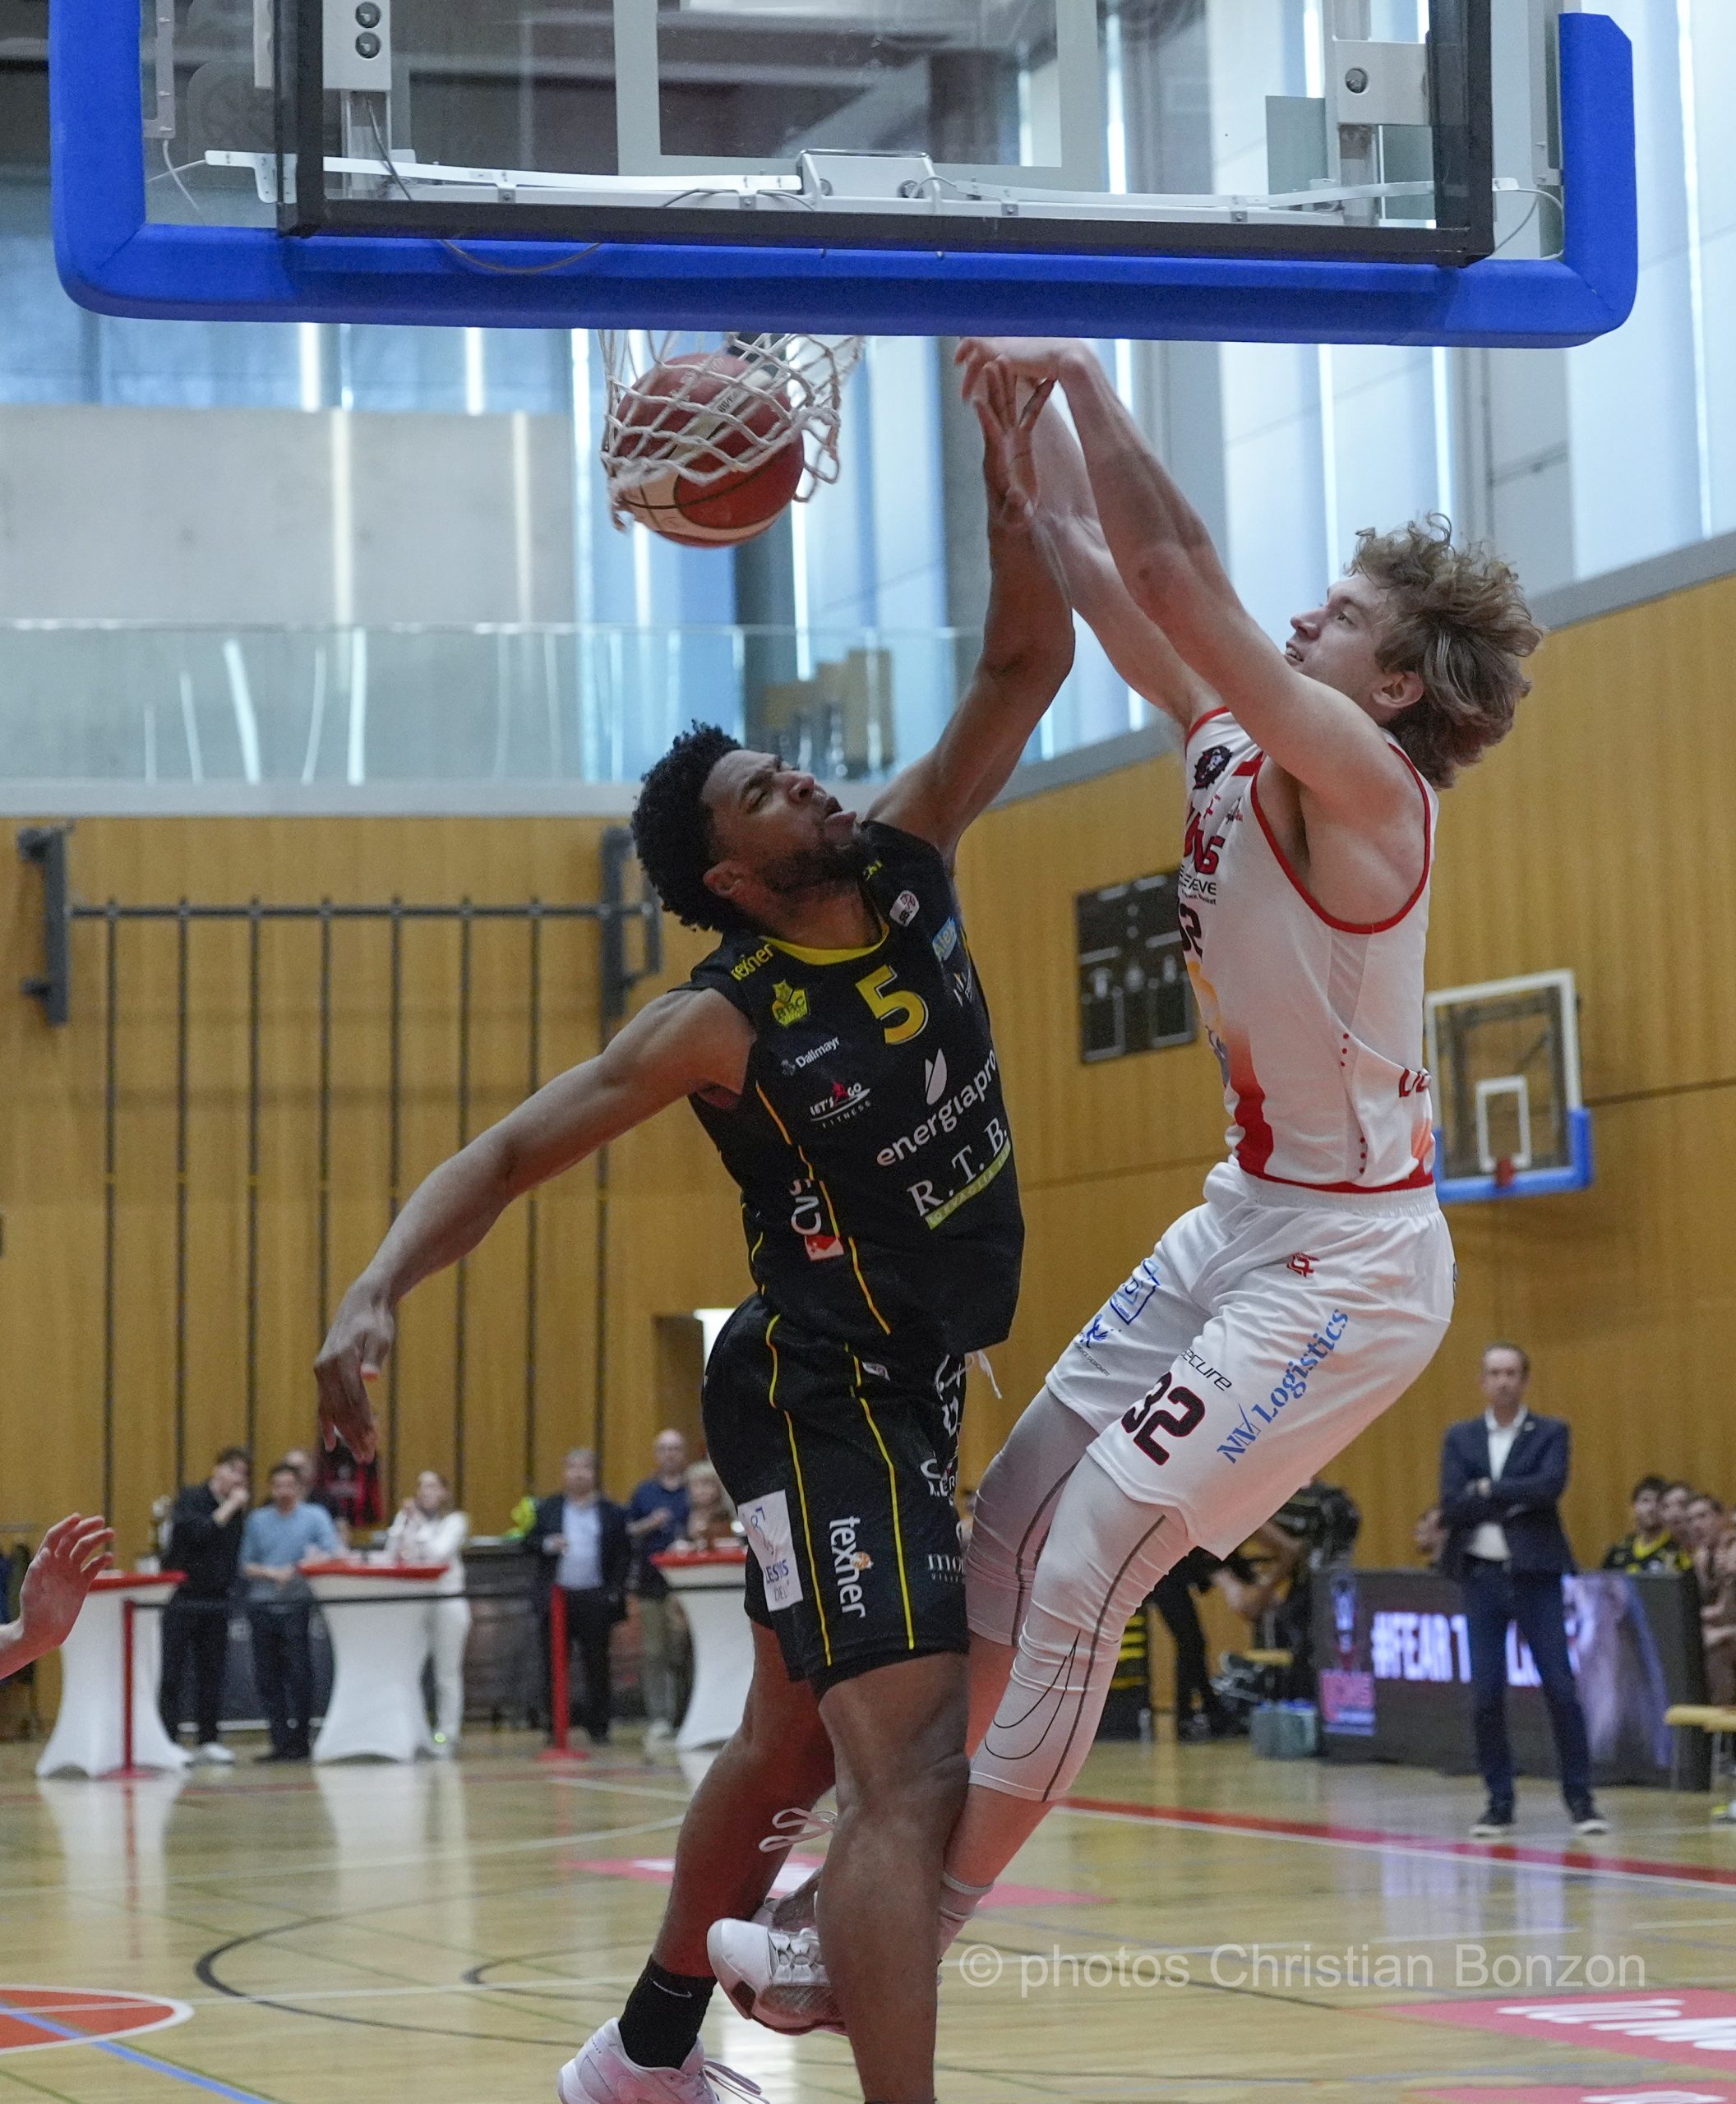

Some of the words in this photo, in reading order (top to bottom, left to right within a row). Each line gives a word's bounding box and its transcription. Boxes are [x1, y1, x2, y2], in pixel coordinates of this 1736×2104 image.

[855, 964, 929, 1045] 5
[795, 1036, 839, 1068] Dallmayr
[810, 1096, 834, 1116] LET'S
[847, 1082, 861, 1097] GO
[876, 1049, 997, 1166] energiapro
[1180, 1347, 1232, 1391] ecure
[1251, 1308, 1349, 1423] Logistics
[1120, 1371, 1206, 1466] 32
[829, 1516, 866, 1618] texner
